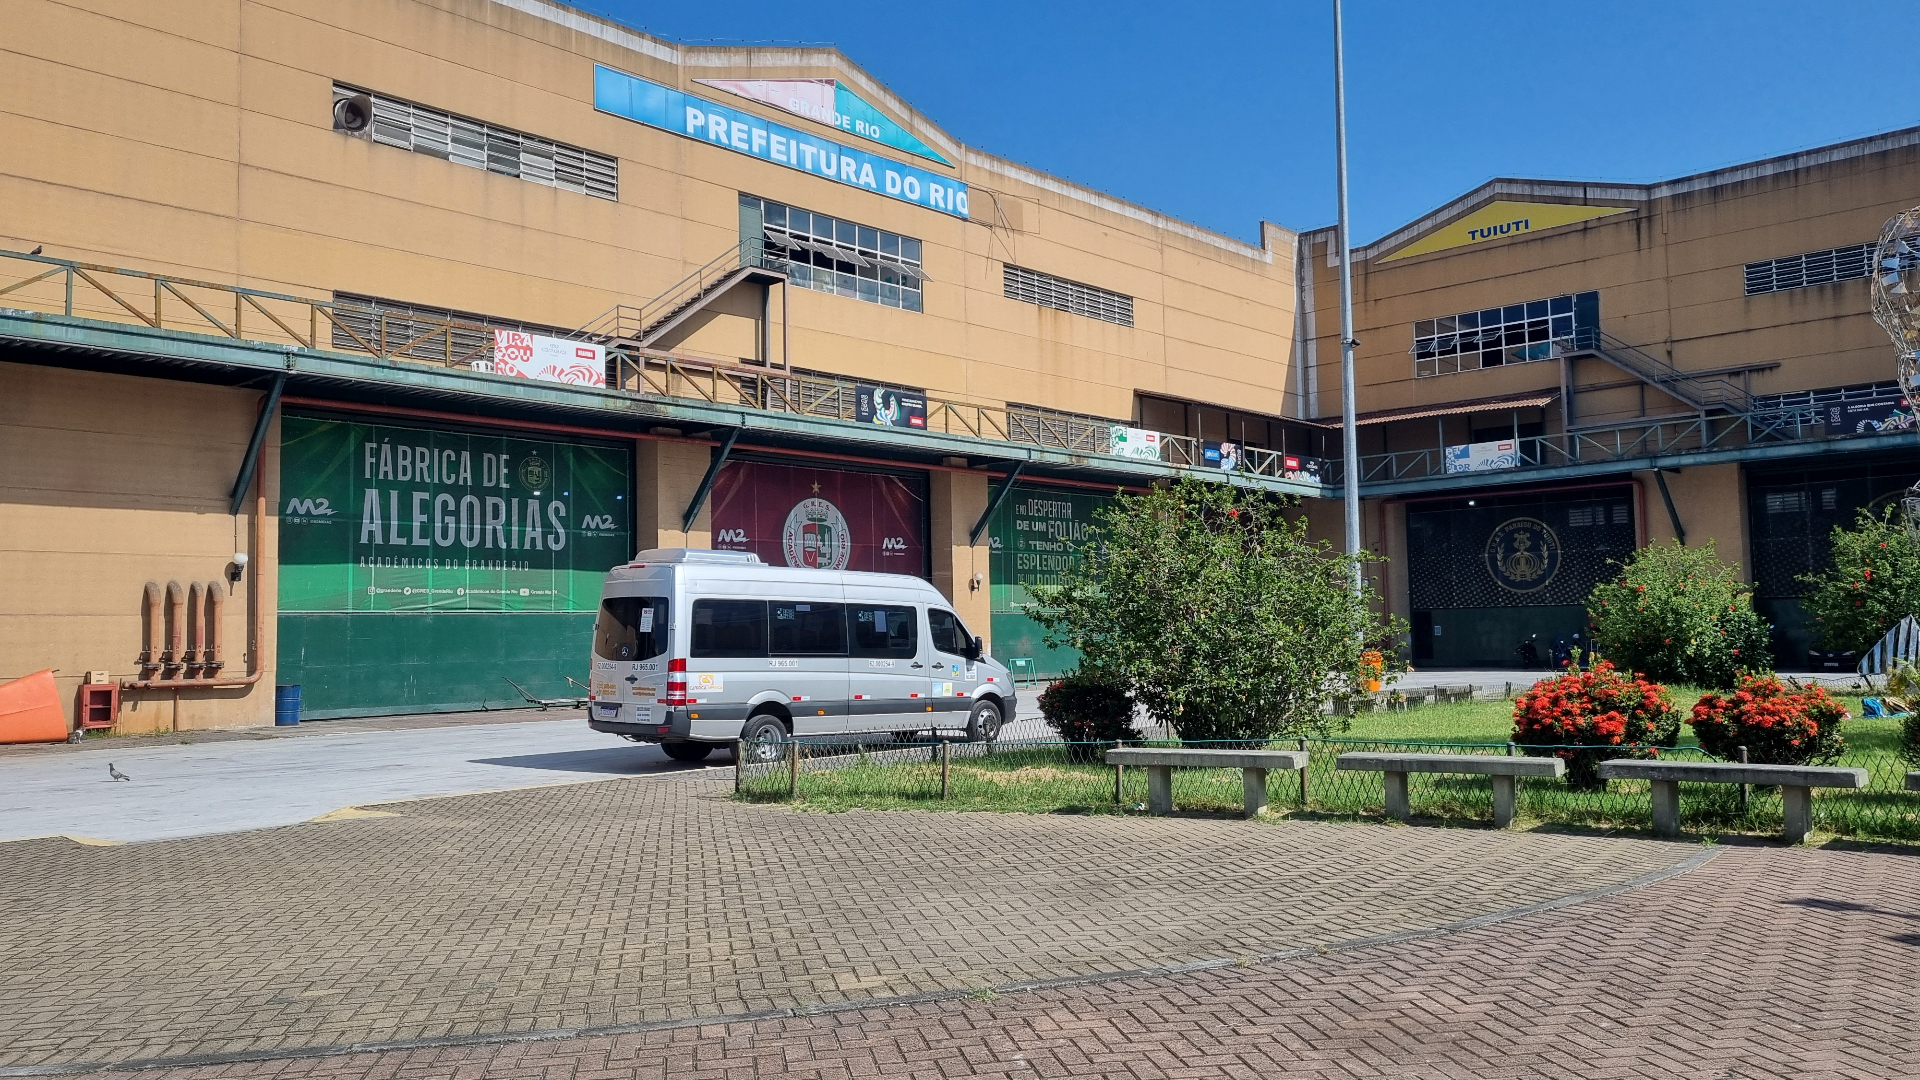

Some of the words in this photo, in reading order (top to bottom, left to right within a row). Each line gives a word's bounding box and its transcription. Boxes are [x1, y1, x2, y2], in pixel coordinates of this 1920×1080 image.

[788, 98, 850, 130] GRANDE
[855, 120, 881, 139] RIO
[686, 106, 876, 189] PREFEITURA
[885, 170, 921, 200] DO
[929, 184, 969, 214] RIO
[1468, 219, 1529, 240] TUIUTI
[495, 329, 534, 347] VIRA
[495, 361, 518, 377] RO
[364, 437, 473, 486] FÁBRICA
[482, 453, 510, 489] DE
[1446, 463, 1471, 473] FLOR
[286, 498, 338, 516] M2
[1016, 504, 1020, 515] E
[1020, 504, 1027, 516] NO
[1028, 498, 1072, 519] DESPERTAR
[359, 488, 567, 551] ALEGORIAS
[581, 514, 619, 530] M2
[718, 529, 750, 543] M2
[1016, 520, 1030, 530] DE
[1032, 521, 1046, 532] UM
[1048, 519, 1089, 541] FOLIÃO
[1532, 523, 1541, 532] DO
[1542, 529, 1556, 550] TUIUTI
[882, 537, 908, 549] M2
[1029, 541, 1063, 552] TENHO
[1066, 542, 1074, 552] O
[360, 556, 439, 570] ACADÊMICOS
[445, 558, 459, 570] DO
[833, 551, 846, 569] NDE
[1017, 553, 1075, 571] ESPLENDOR
[632, 663, 638, 671] RJ
